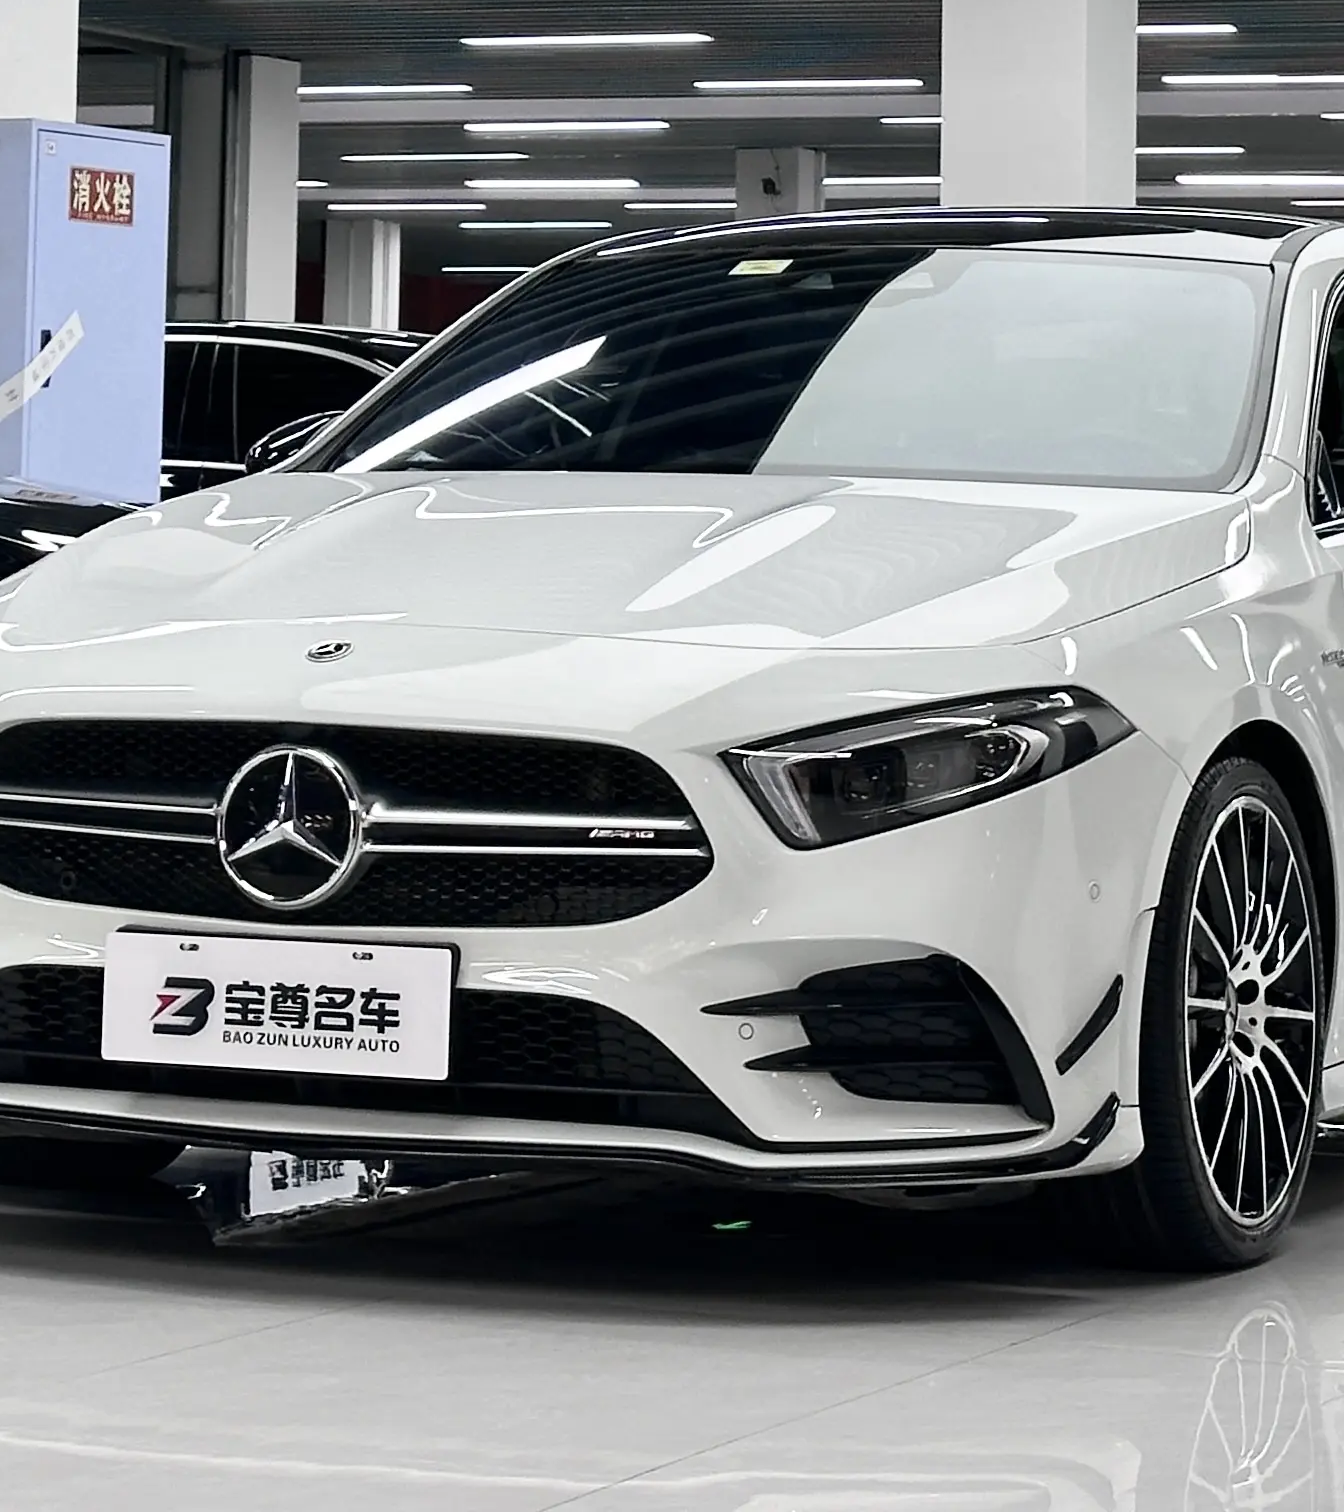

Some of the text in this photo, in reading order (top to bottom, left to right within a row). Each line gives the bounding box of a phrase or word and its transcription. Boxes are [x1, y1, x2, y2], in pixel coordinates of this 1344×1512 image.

[73, 170, 132, 216] 消火栓
[224, 981, 401, 1034] 宝尊名车
[222, 1031, 400, 1053] BAO ZUN LUXURY AUTO
